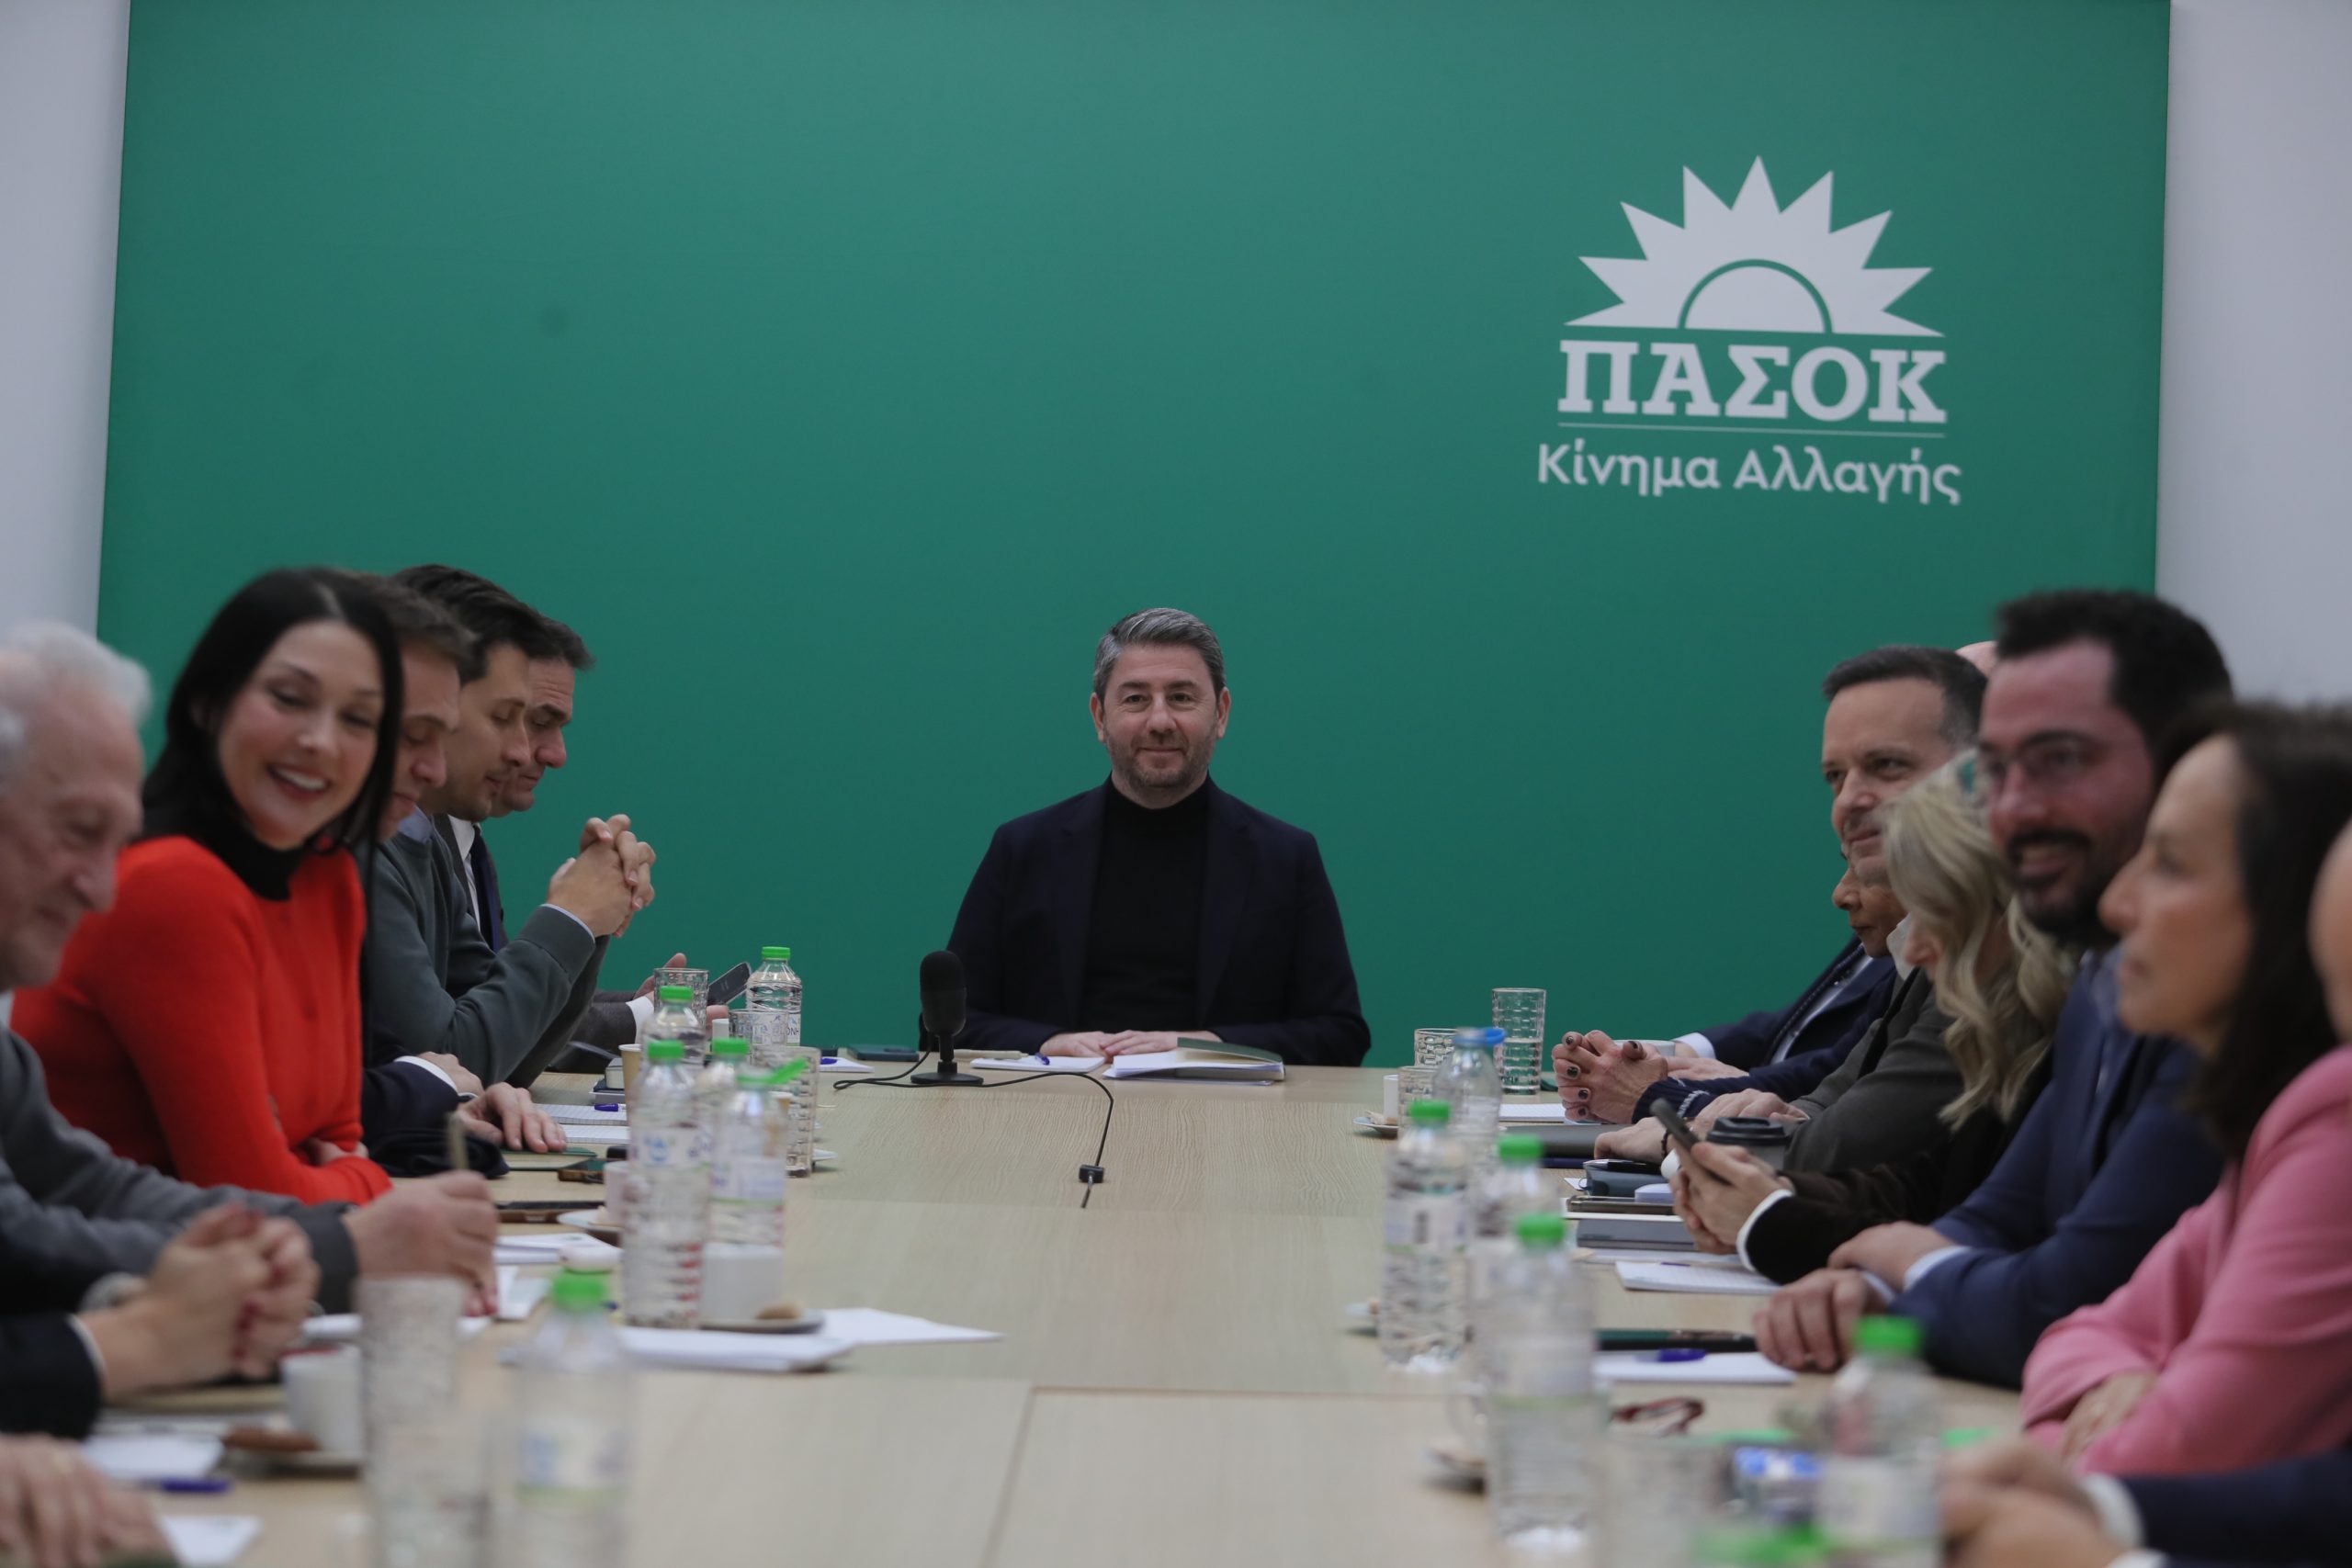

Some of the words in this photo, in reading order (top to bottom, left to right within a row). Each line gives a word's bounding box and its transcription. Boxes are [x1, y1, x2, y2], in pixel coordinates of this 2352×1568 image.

[1558, 340, 1946, 423] ΠΑΣΟΚ
[1538, 438, 1720, 496] Κίνημα
[1734, 446, 1961, 504] Αλλαγής
